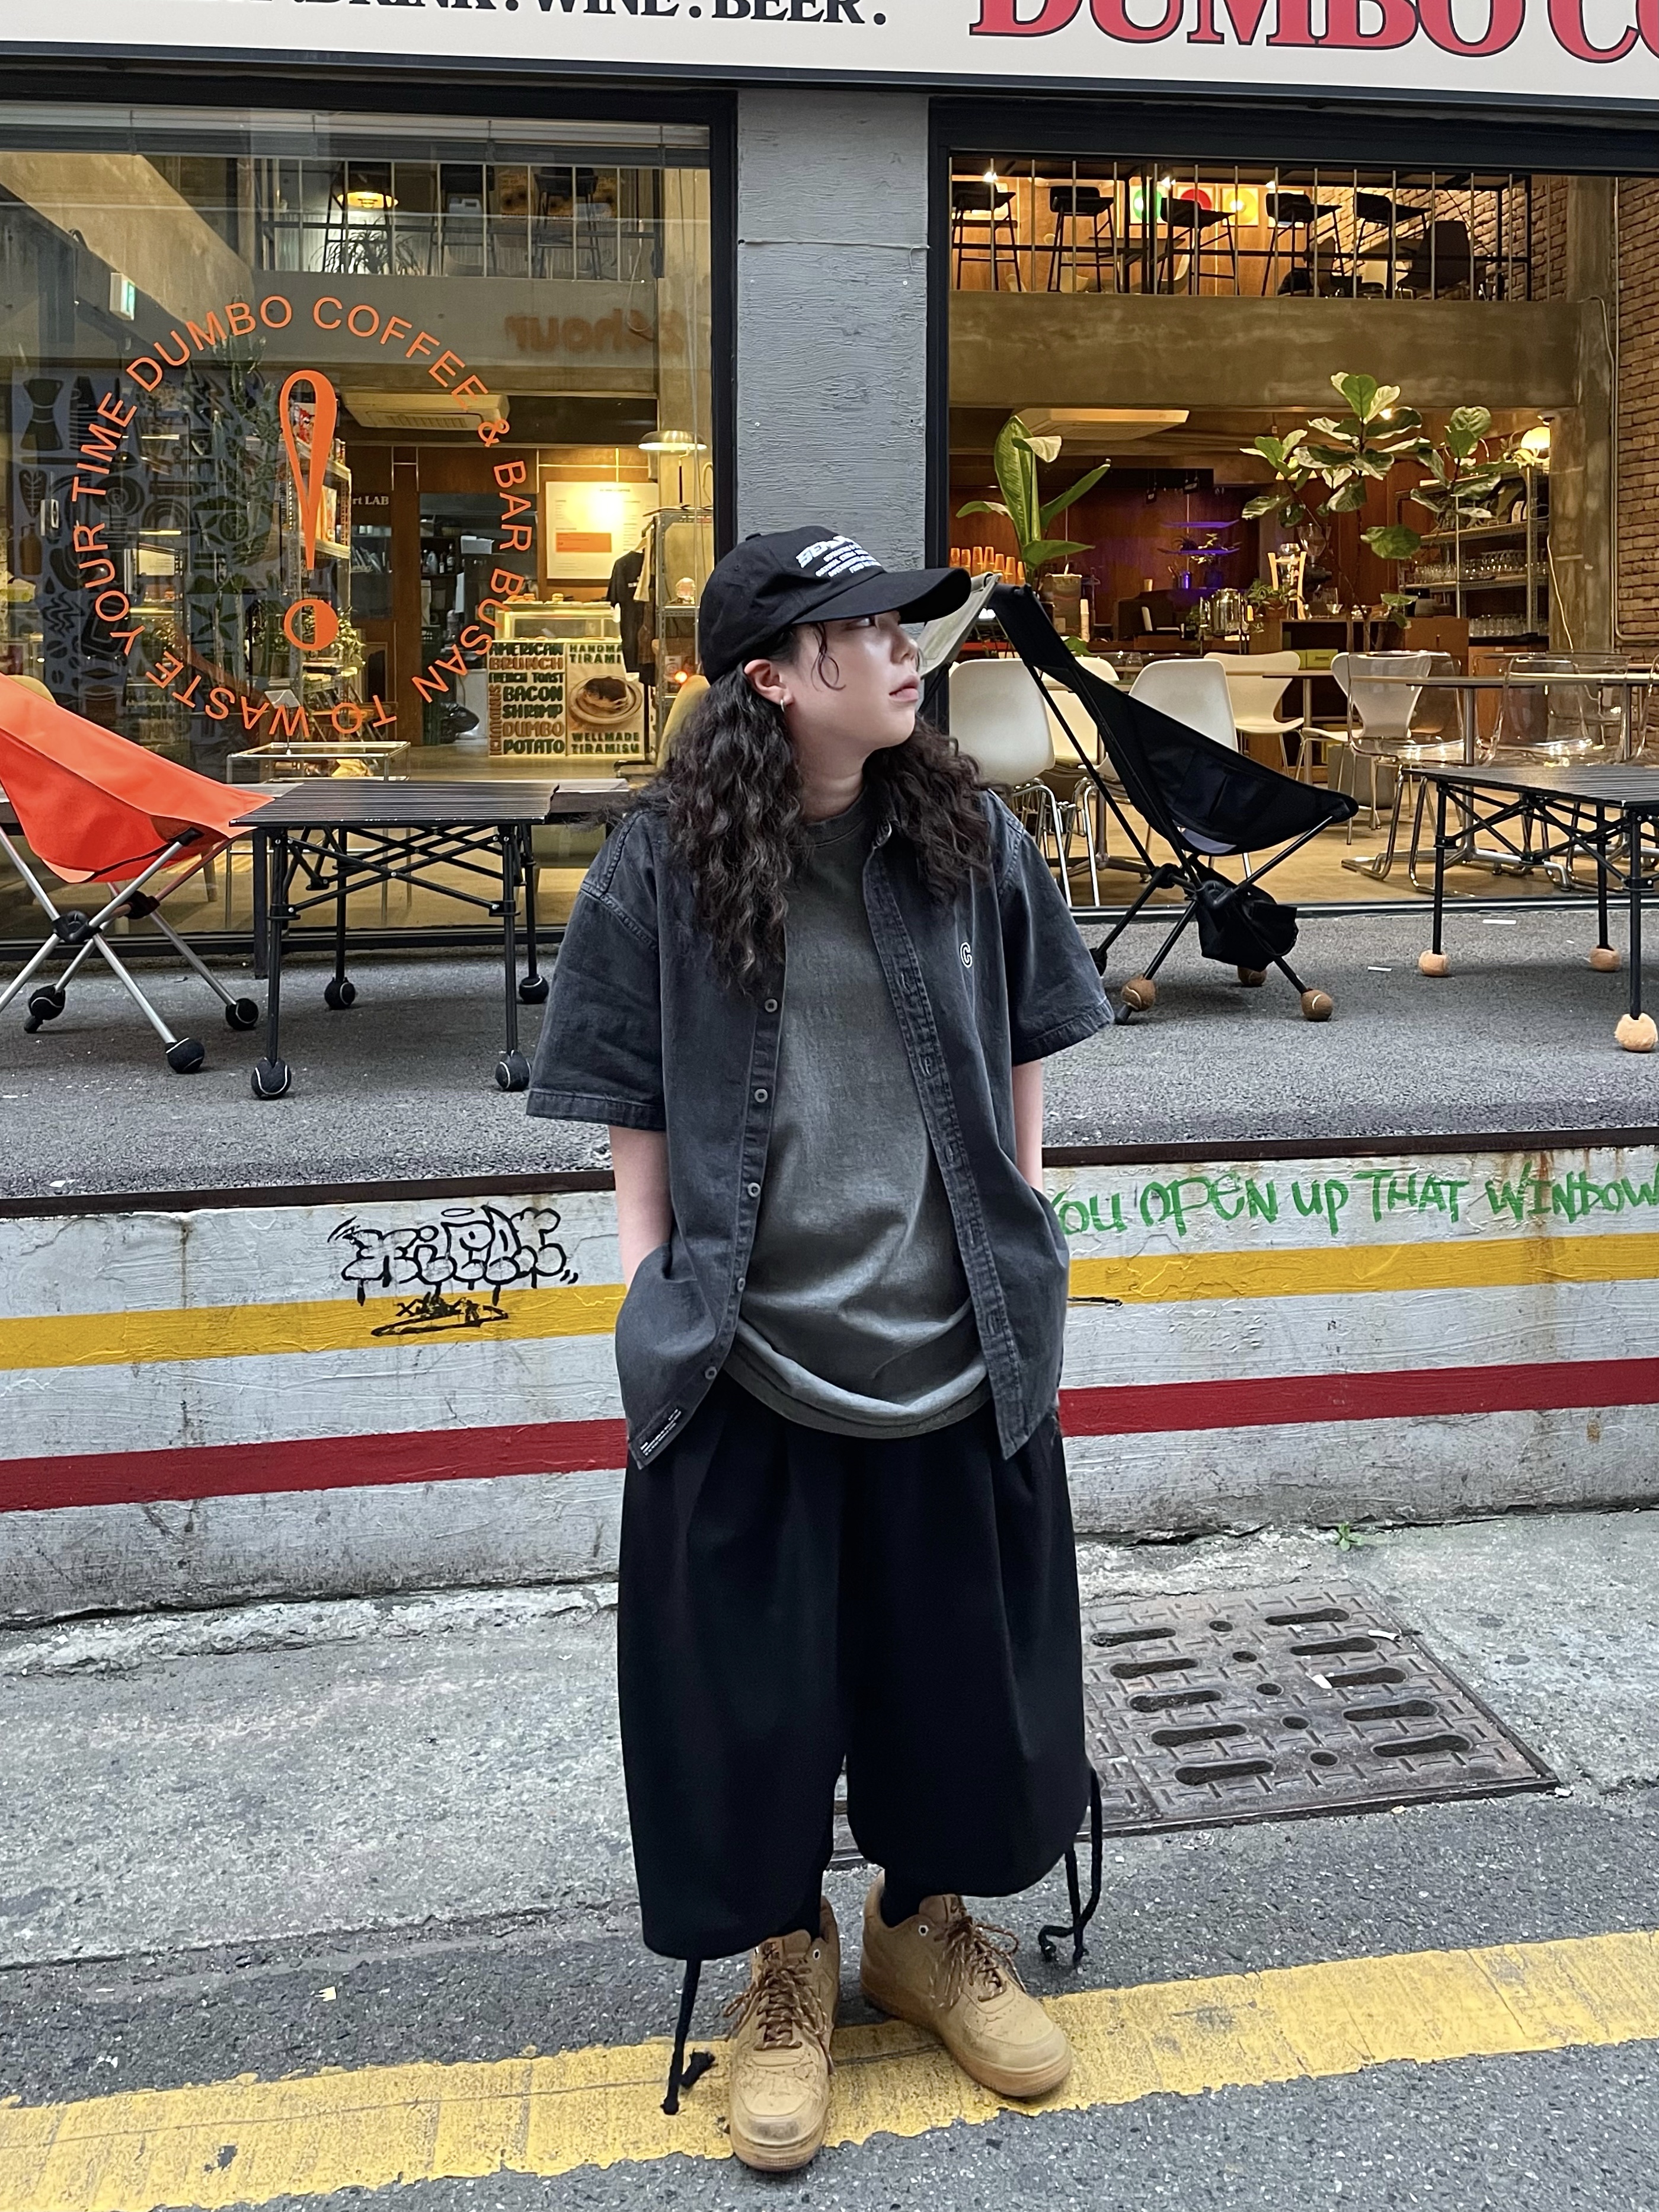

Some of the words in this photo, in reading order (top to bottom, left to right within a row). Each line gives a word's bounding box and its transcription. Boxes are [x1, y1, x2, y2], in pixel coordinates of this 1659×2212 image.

[126, 295, 292, 392] DUMBO
[312, 296, 489, 411] COFFEE
[477, 417, 510, 448] &
[72, 391, 137, 503] TIME
[365, 496, 389, 505] LAB
[494, 460, 532, 551] BAR
[73, 523, 145, 656] YOUR
[411, 568, 525, 703] BUSAN
[488, 642, 563, 656] AMERICAN
[569, 644, 623, 653] HANDMA
[488, 657, 563, 670] BRUNCH
[569, 654, 621, 664] TIRAMI
[532, 672, 565, 683] TOAST
[145, 651, 310, 738] WASTE
[503, 685, 563, 702] BACON
[331, 695, 397, 735] TO
[502, 704, 564, 719] SHRIMP
[503, 721, 565, 737] DUMBO
[571, 732, 640, 741] WELLMADE
[503, 739, 565, 755] POTATO
[571, 743, 640, 754] TIRAMISU
[1352, 1168, 1471, 1223] THAT
